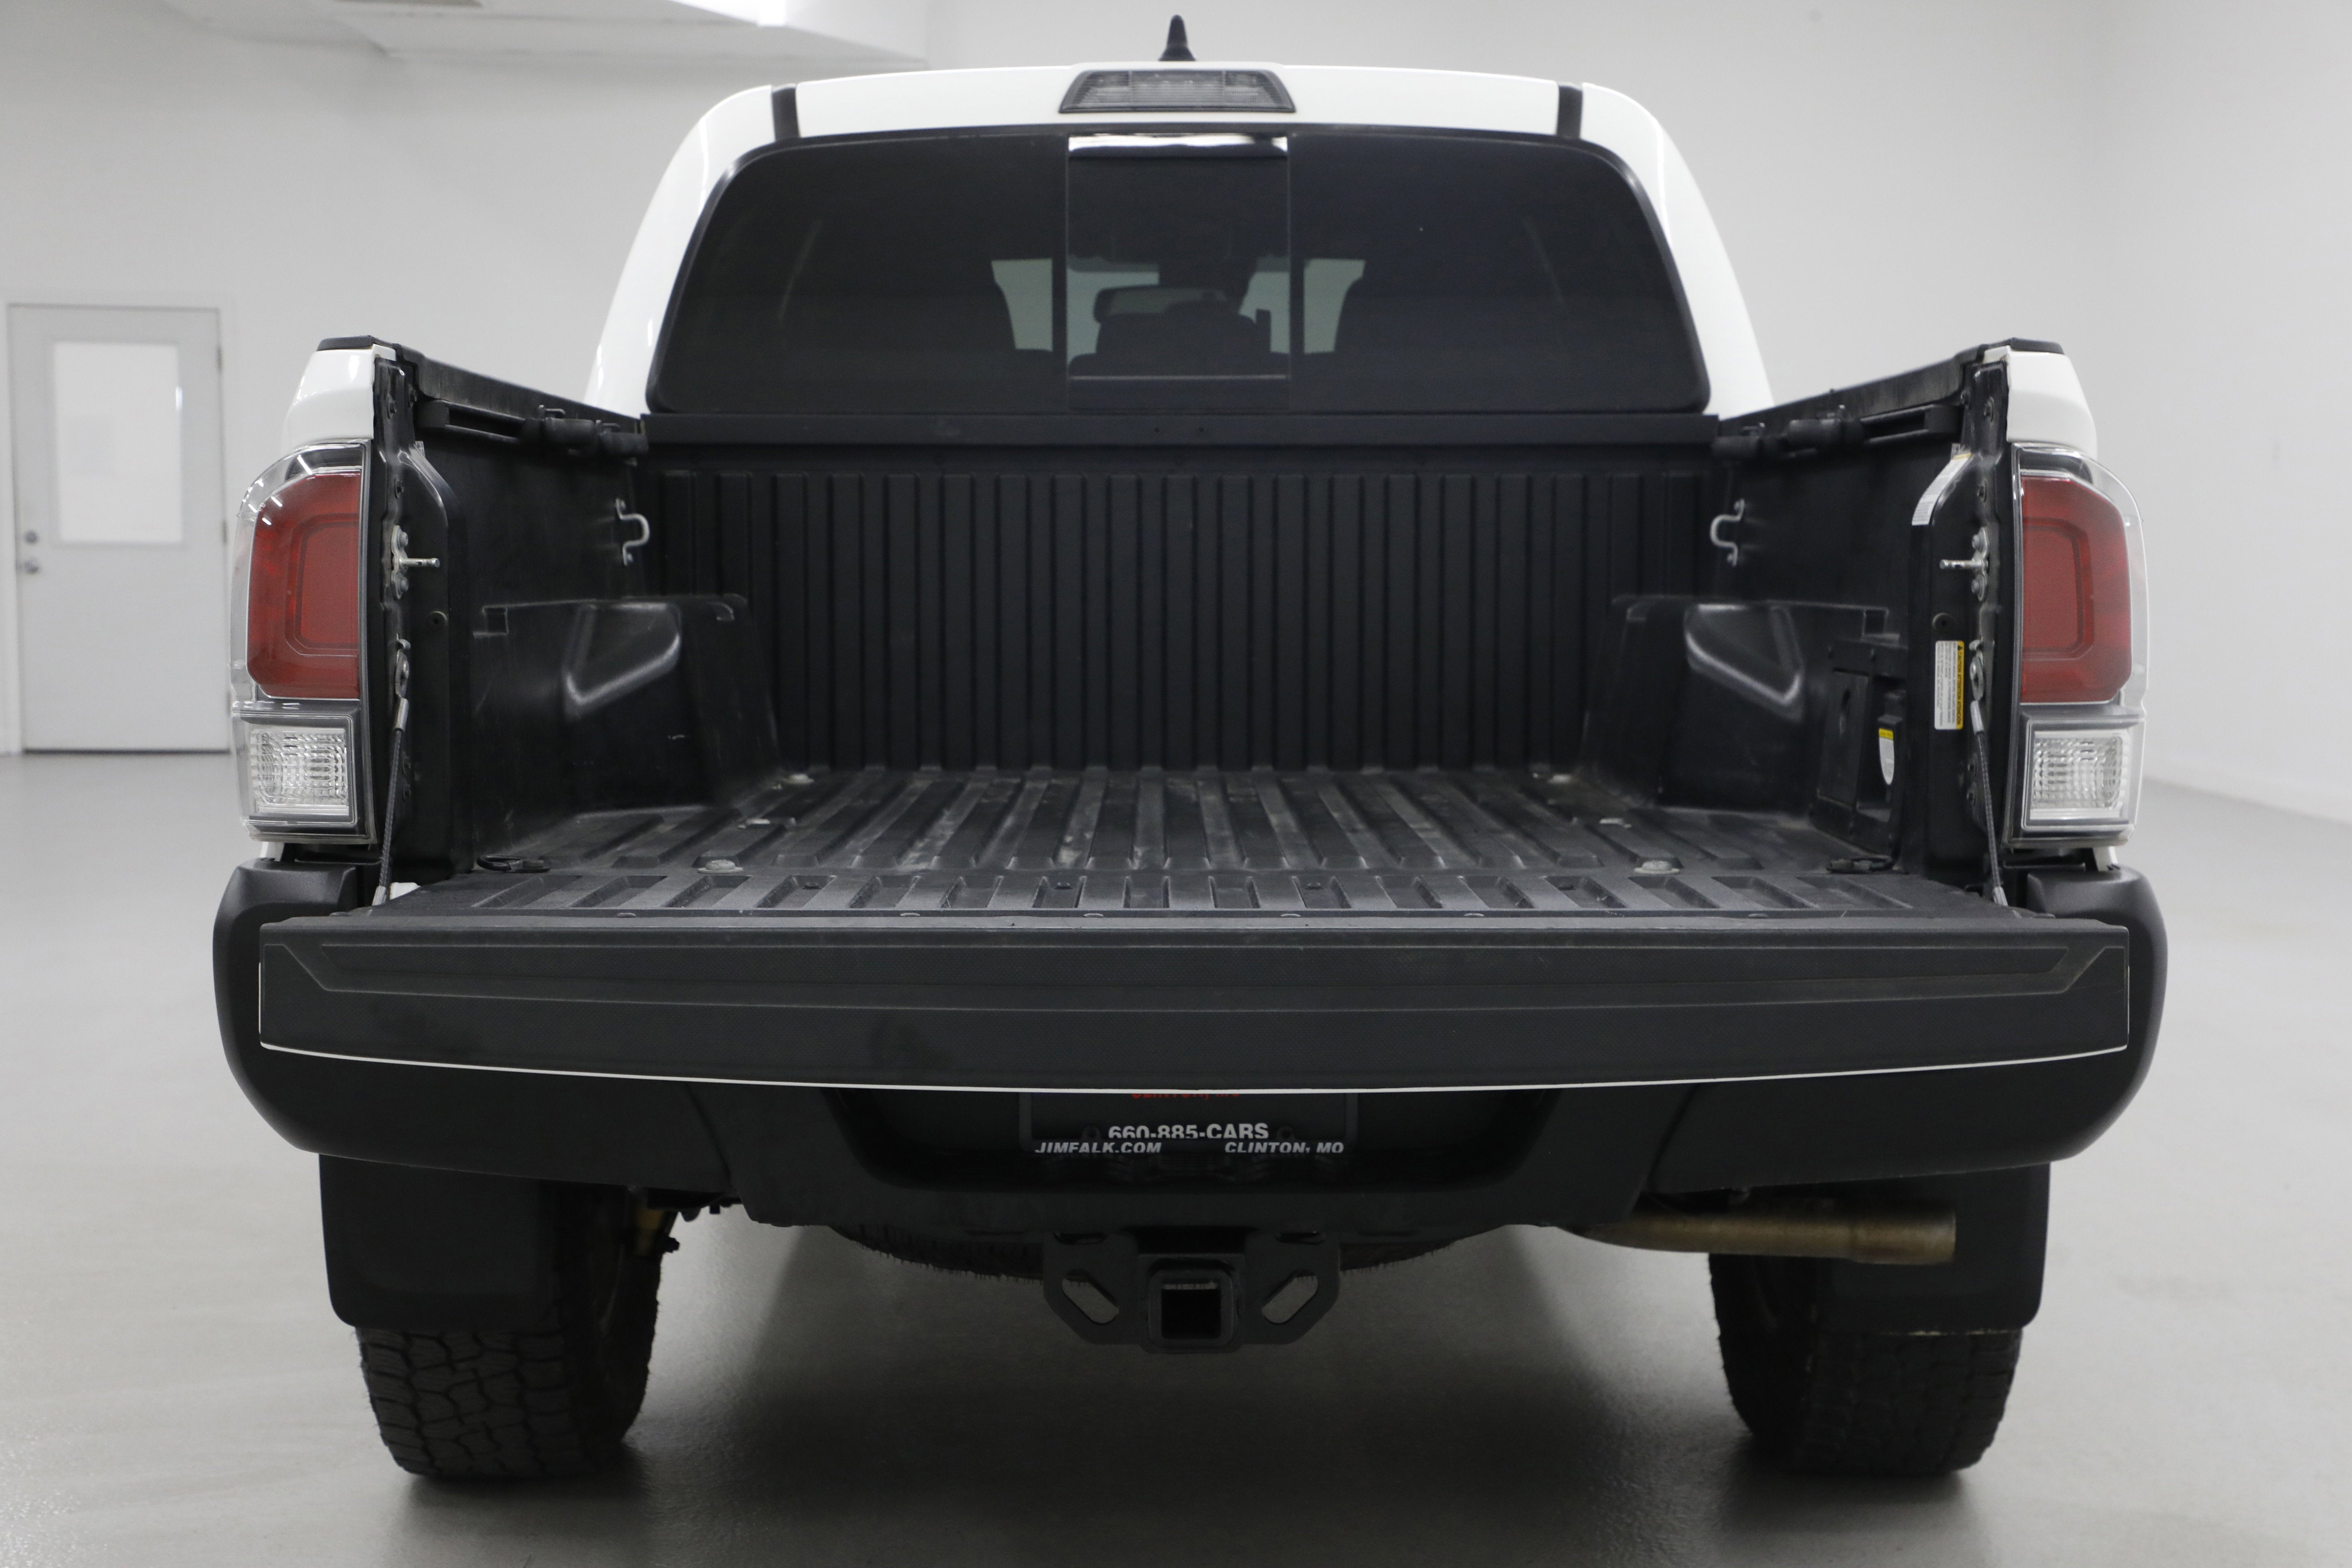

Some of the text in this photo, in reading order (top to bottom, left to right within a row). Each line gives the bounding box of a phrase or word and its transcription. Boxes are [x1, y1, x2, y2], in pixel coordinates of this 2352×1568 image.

[1108, 1123, 1269, 1139] 660-885-CARS
[1035, 1142, 1162, 1153] JIMFALK.COM
[1225, 1142, 1344, 1153] CLINTON, MO
